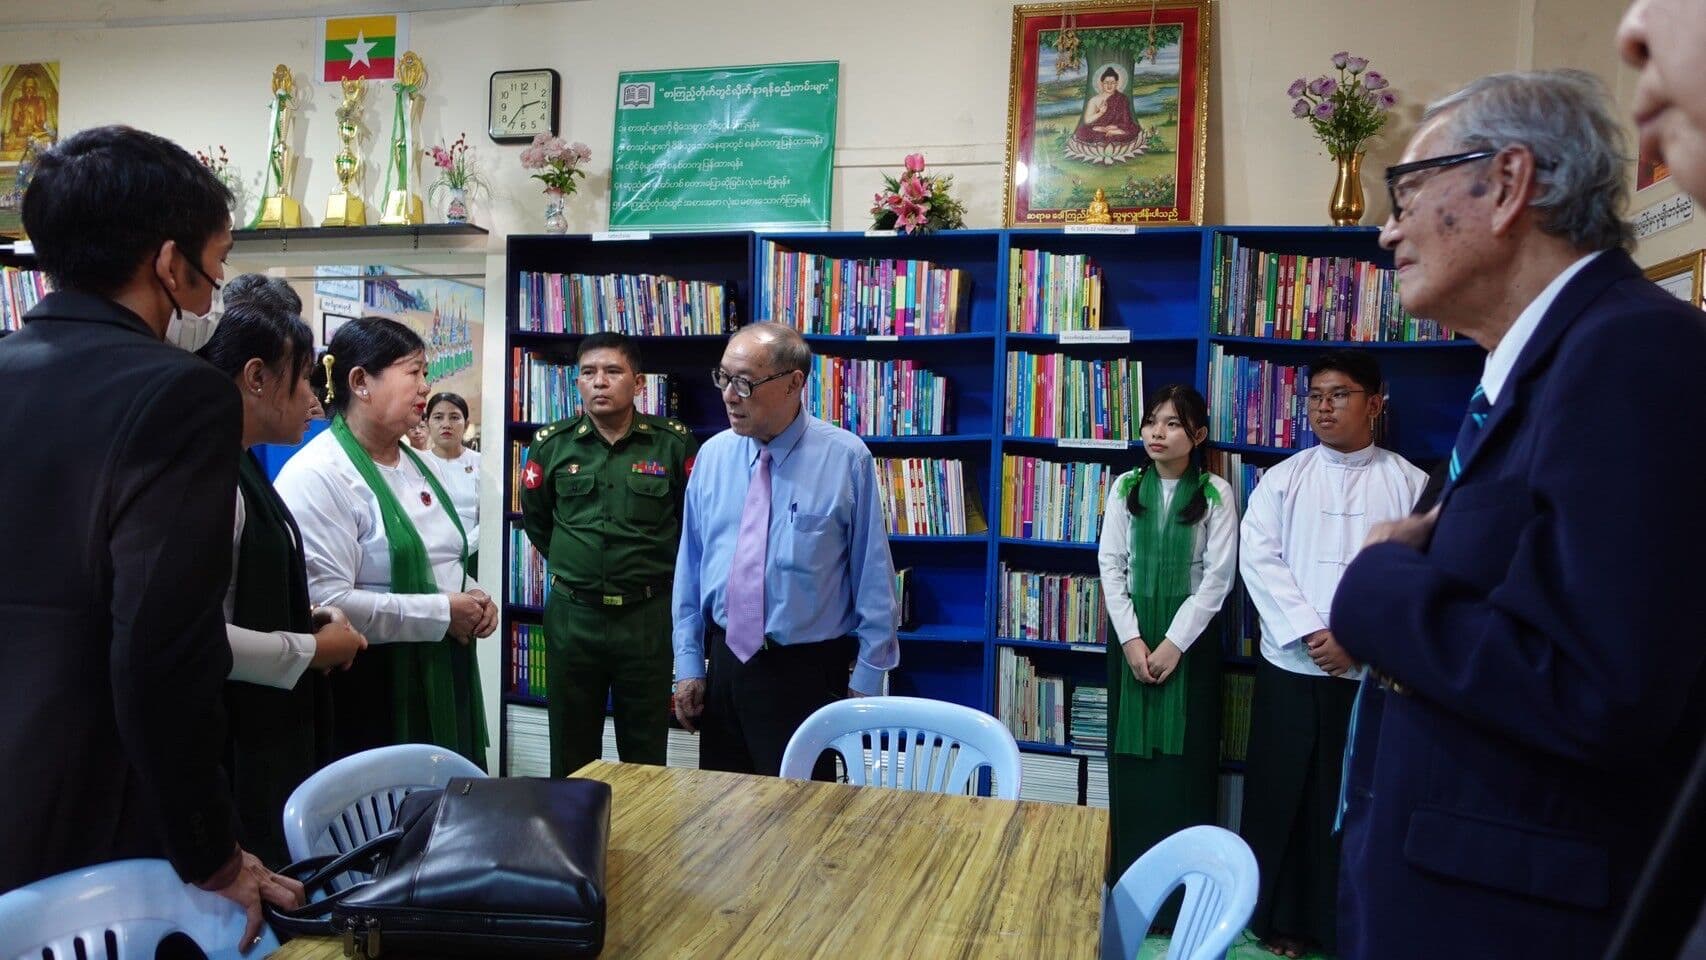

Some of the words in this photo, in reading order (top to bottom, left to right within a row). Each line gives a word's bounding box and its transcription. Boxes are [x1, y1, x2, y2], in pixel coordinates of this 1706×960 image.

[511, 83, 517, 91] 11
[521, 82, 528, 90] 12
[541, 89, 546, 97] 2
[501, 103, 507, 111] 9
[541, 101, 547, 109] 3
[502, 115, 507, 123] 8
[521, 121, 526, 129] 6
[531, 121, 537, 129] 5
